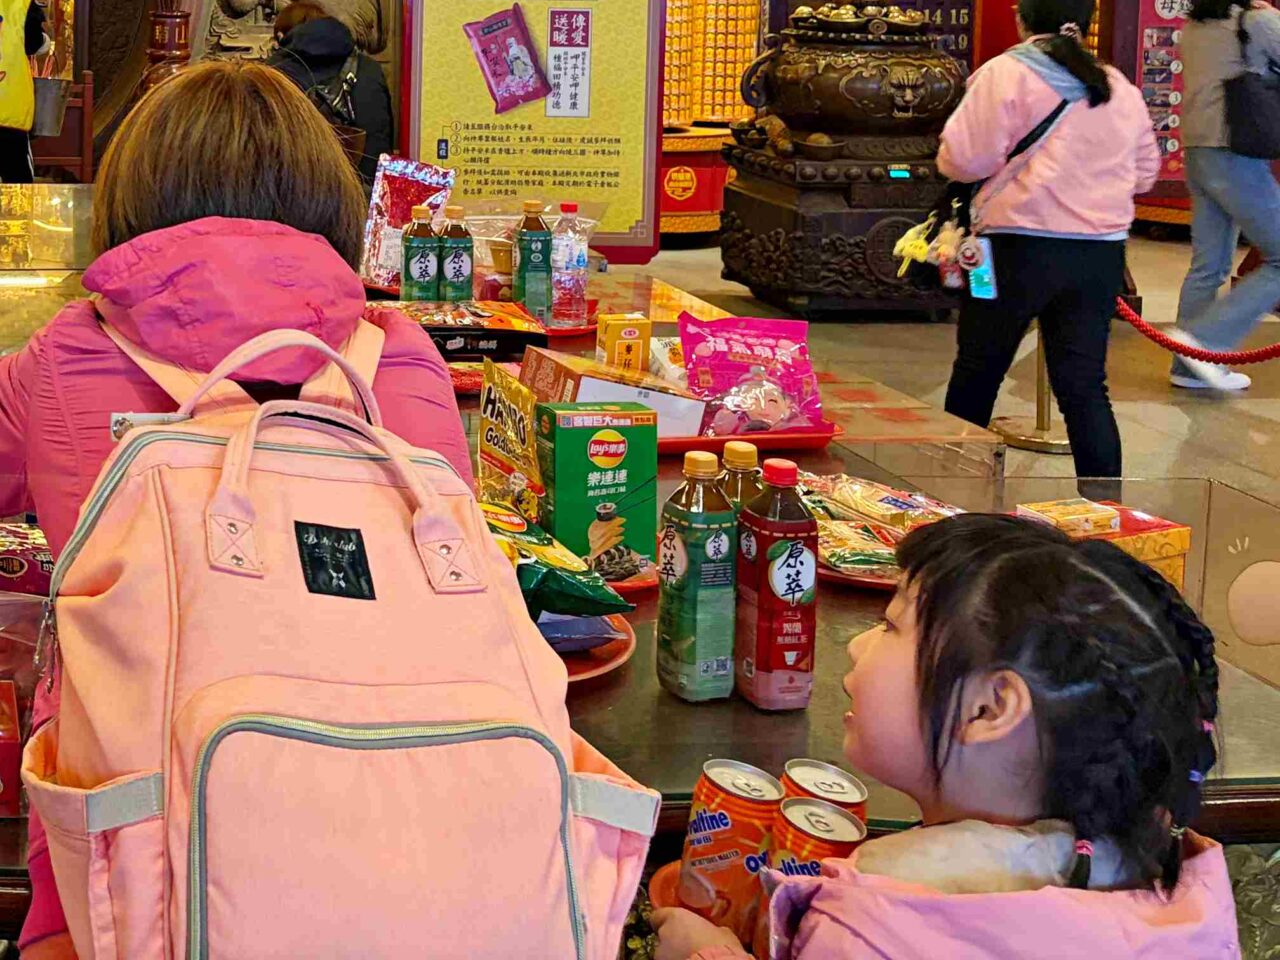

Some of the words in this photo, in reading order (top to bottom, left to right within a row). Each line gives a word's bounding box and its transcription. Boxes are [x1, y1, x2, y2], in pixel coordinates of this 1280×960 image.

[551, 13, 570, 46] 送暖
[570, 13, 588, 46] 傳愛
[923, 8, 943, 25] 14
[950, 8, 970, 25] 15
[415, 248, 432, 285] 原萃
[448, 248, 466, 285] 原萃
[776, 541, 805, 606] 原萃
